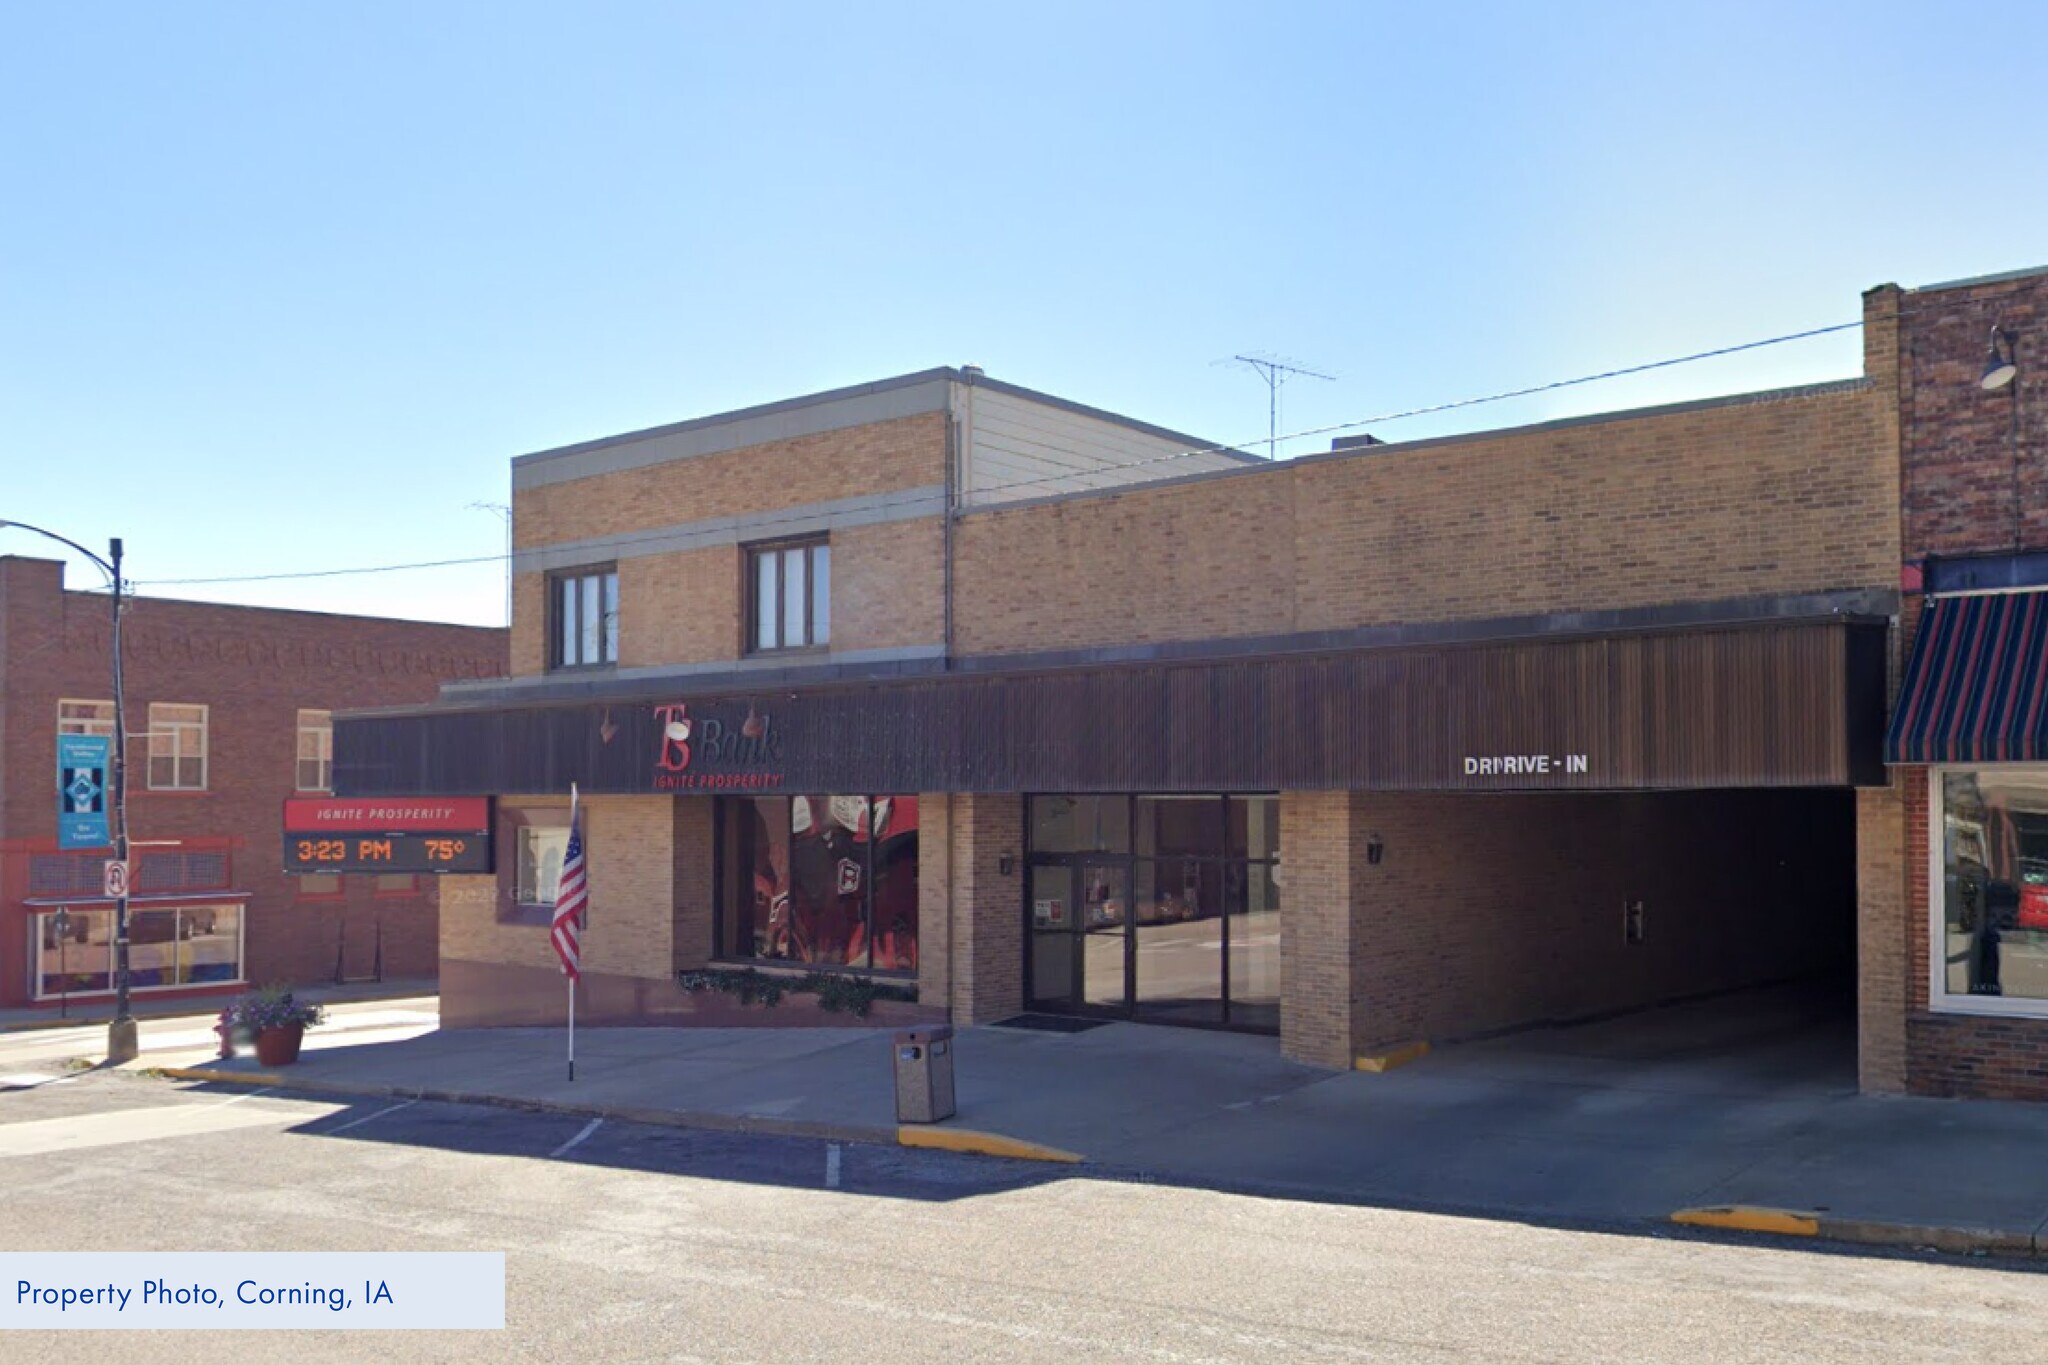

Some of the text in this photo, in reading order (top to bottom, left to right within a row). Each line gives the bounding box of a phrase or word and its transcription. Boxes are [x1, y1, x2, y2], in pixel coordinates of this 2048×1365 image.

[700, 714, 779, 764] Bank
[654, 774, 695, 789] IGNITE
[317, 808, 363, 820] IGNITE
[298, 839, 346, 861] 3:23
[358, 839, 392, 861] PM
